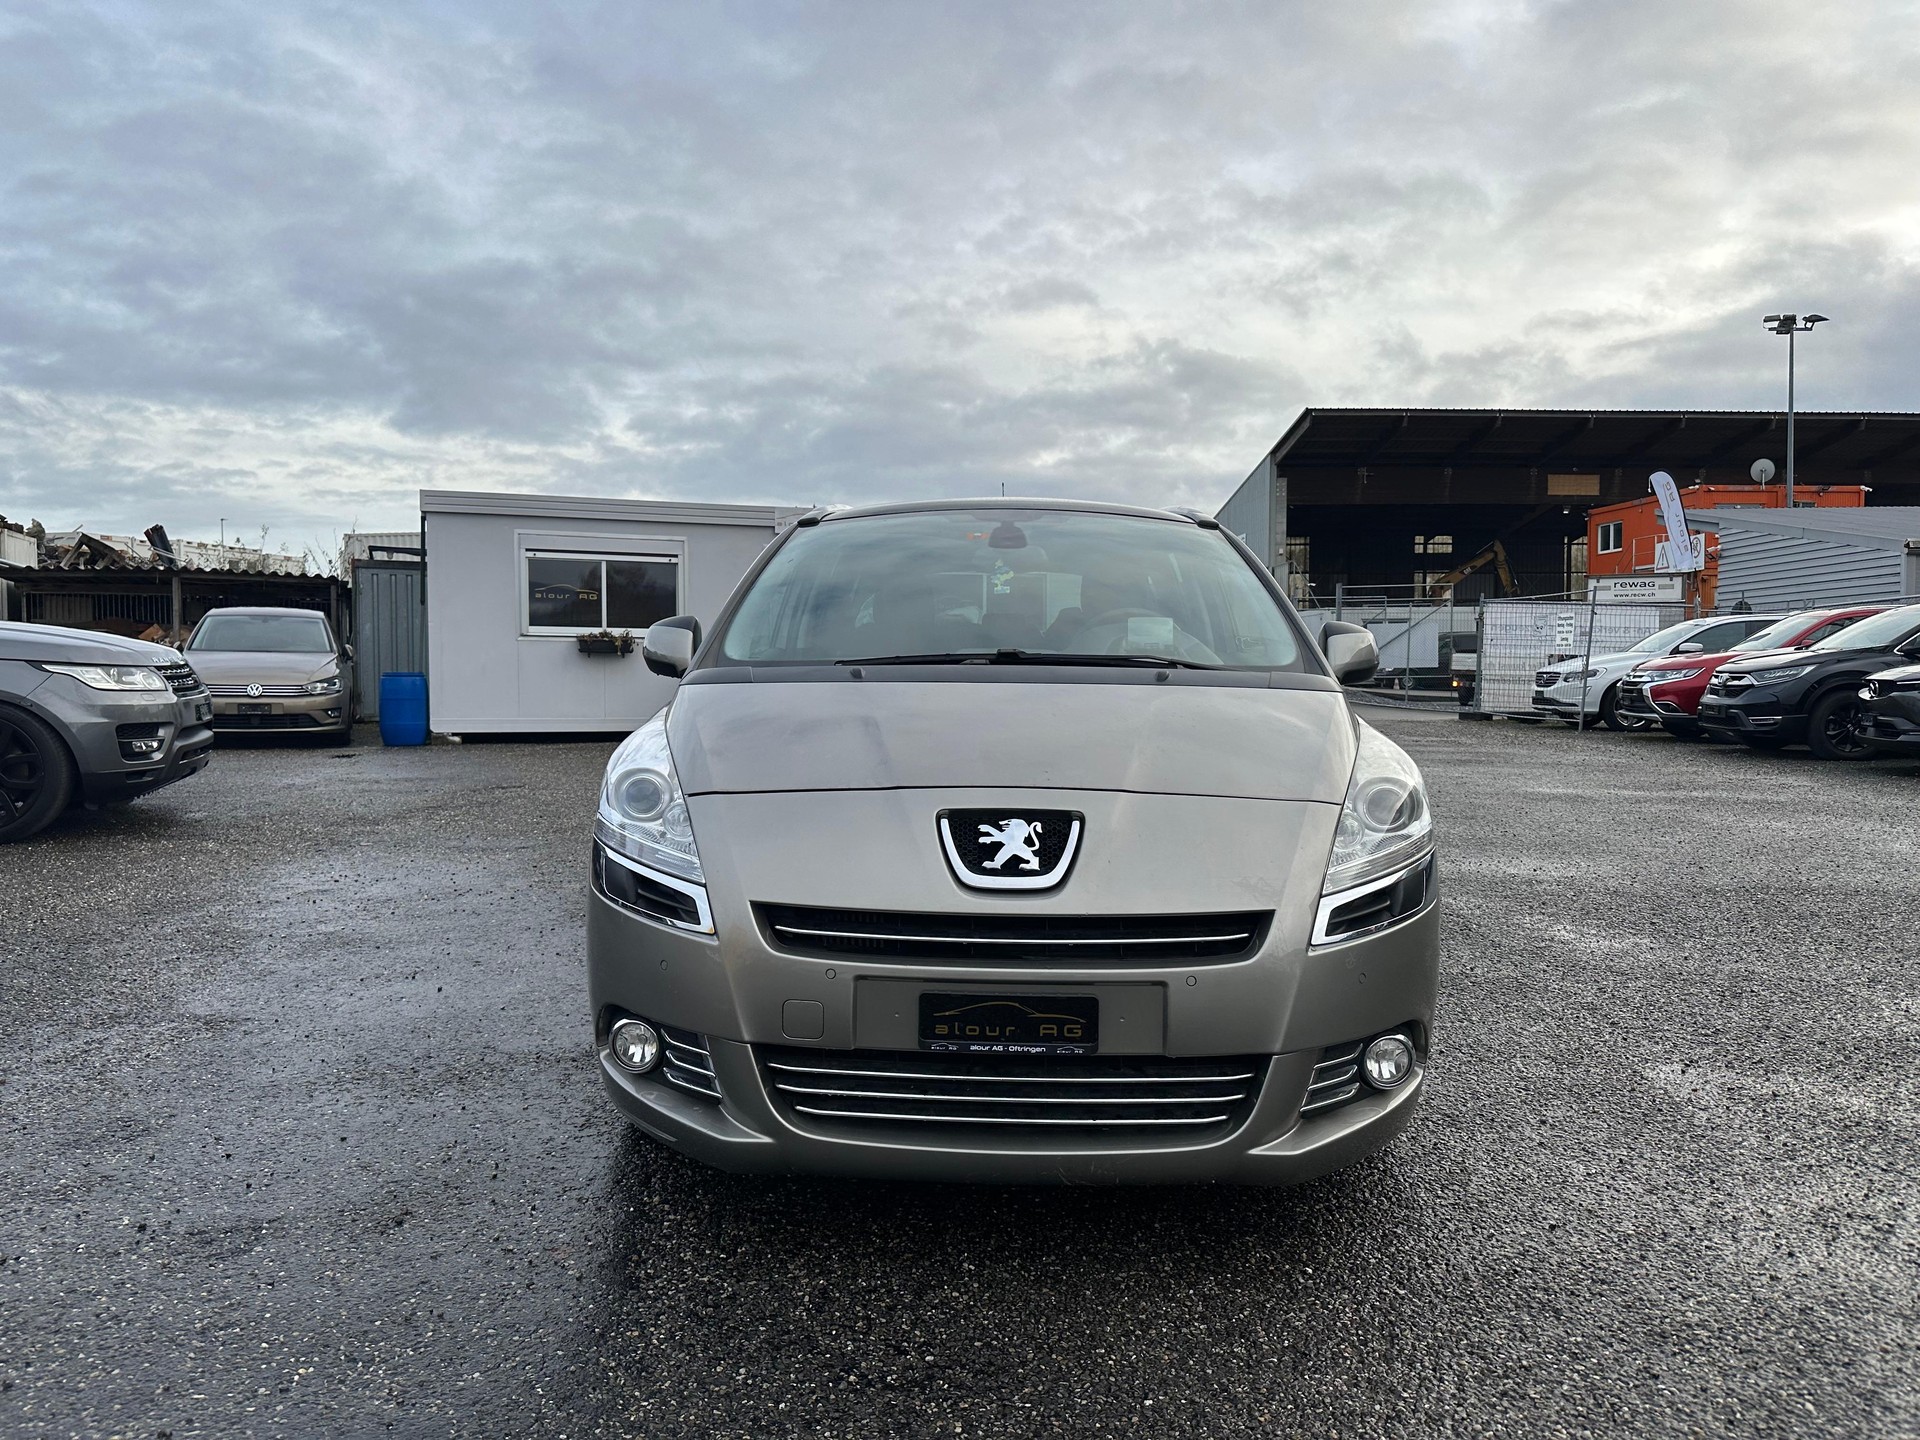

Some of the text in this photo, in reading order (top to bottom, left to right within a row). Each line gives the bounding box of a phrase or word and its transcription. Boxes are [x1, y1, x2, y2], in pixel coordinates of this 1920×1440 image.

[934, 1021, 1083, 1038] alour AG
[1008, 1045, 1047, 1054] Oftringen
